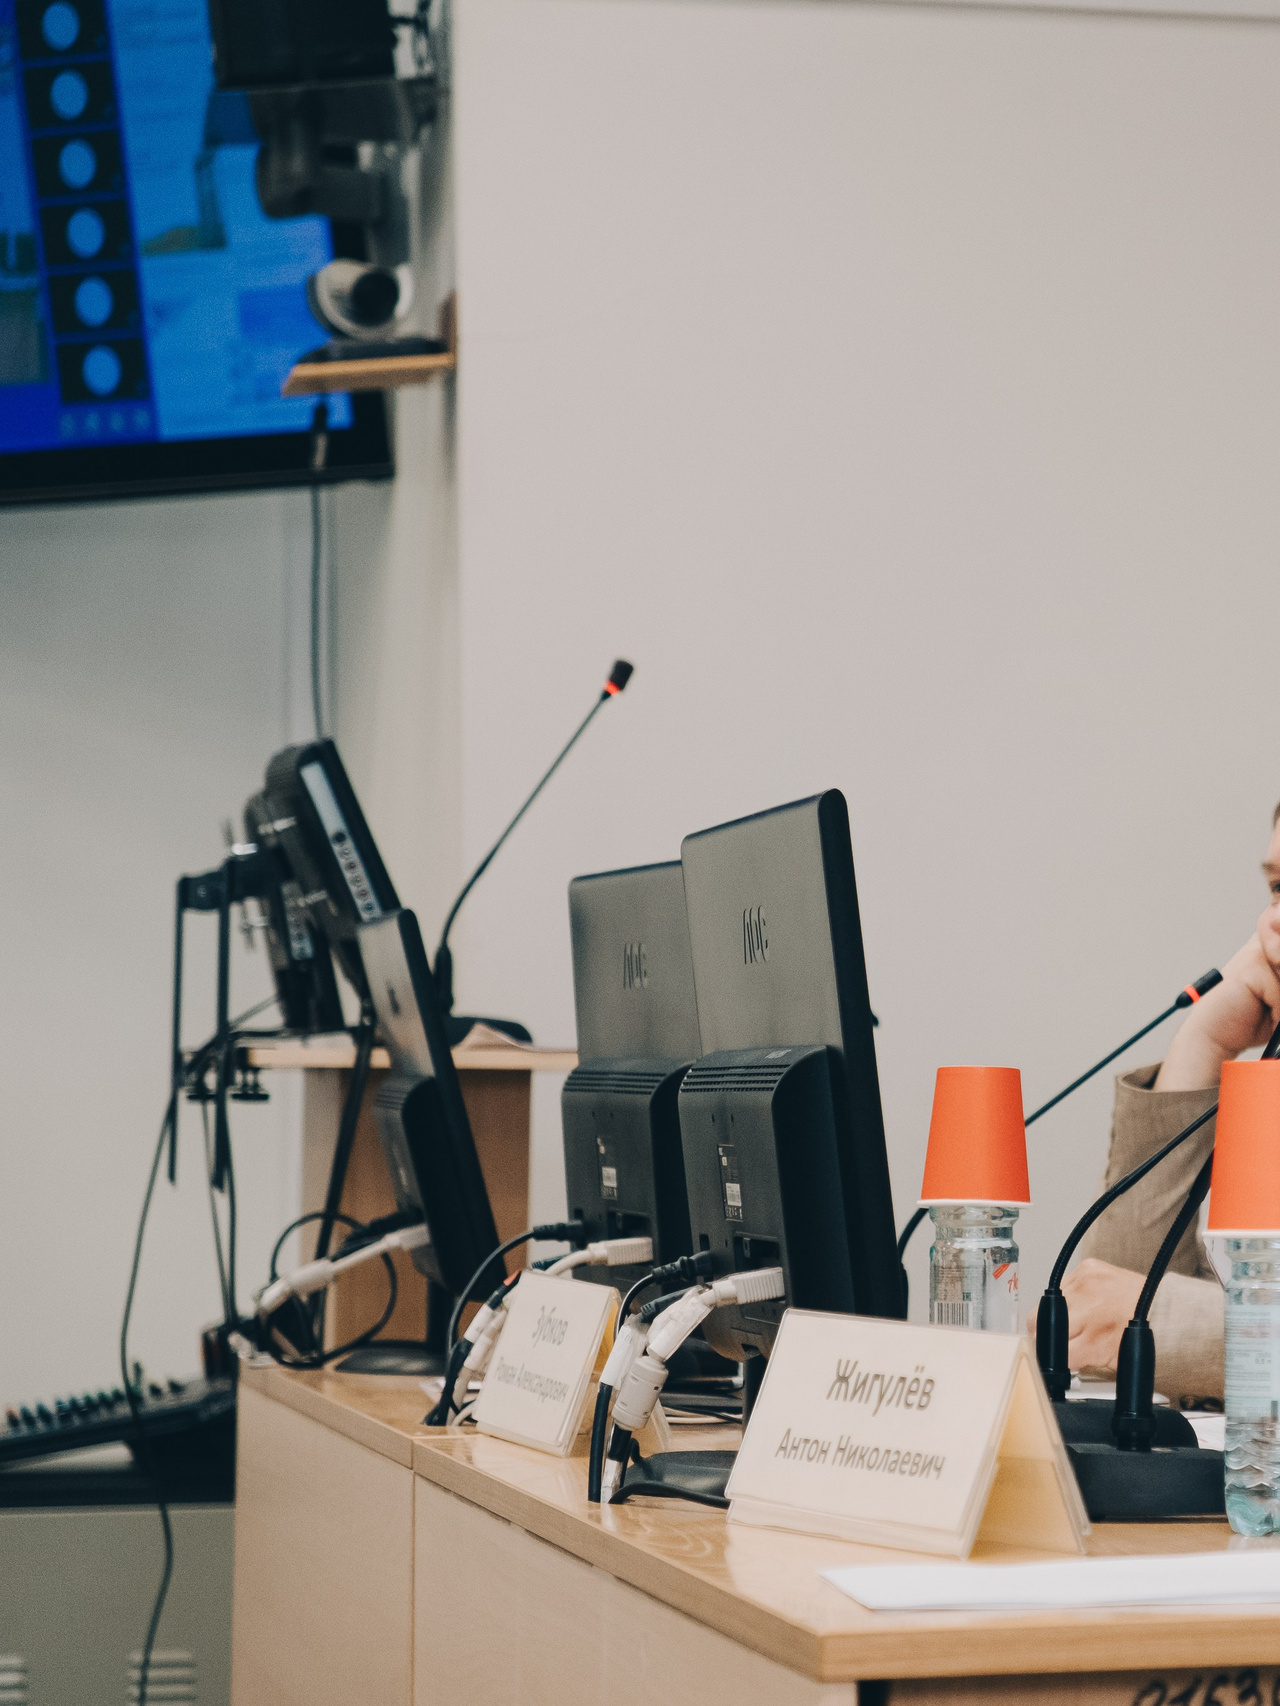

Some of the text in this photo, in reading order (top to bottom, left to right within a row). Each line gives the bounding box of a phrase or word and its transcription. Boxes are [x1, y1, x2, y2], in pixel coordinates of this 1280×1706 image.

[531, 1305, 569, 1348] Зубков
[825, 1358, 936, 1417] Жигулёв
[774, 1427, 947, 1481] Антон Николаевич
